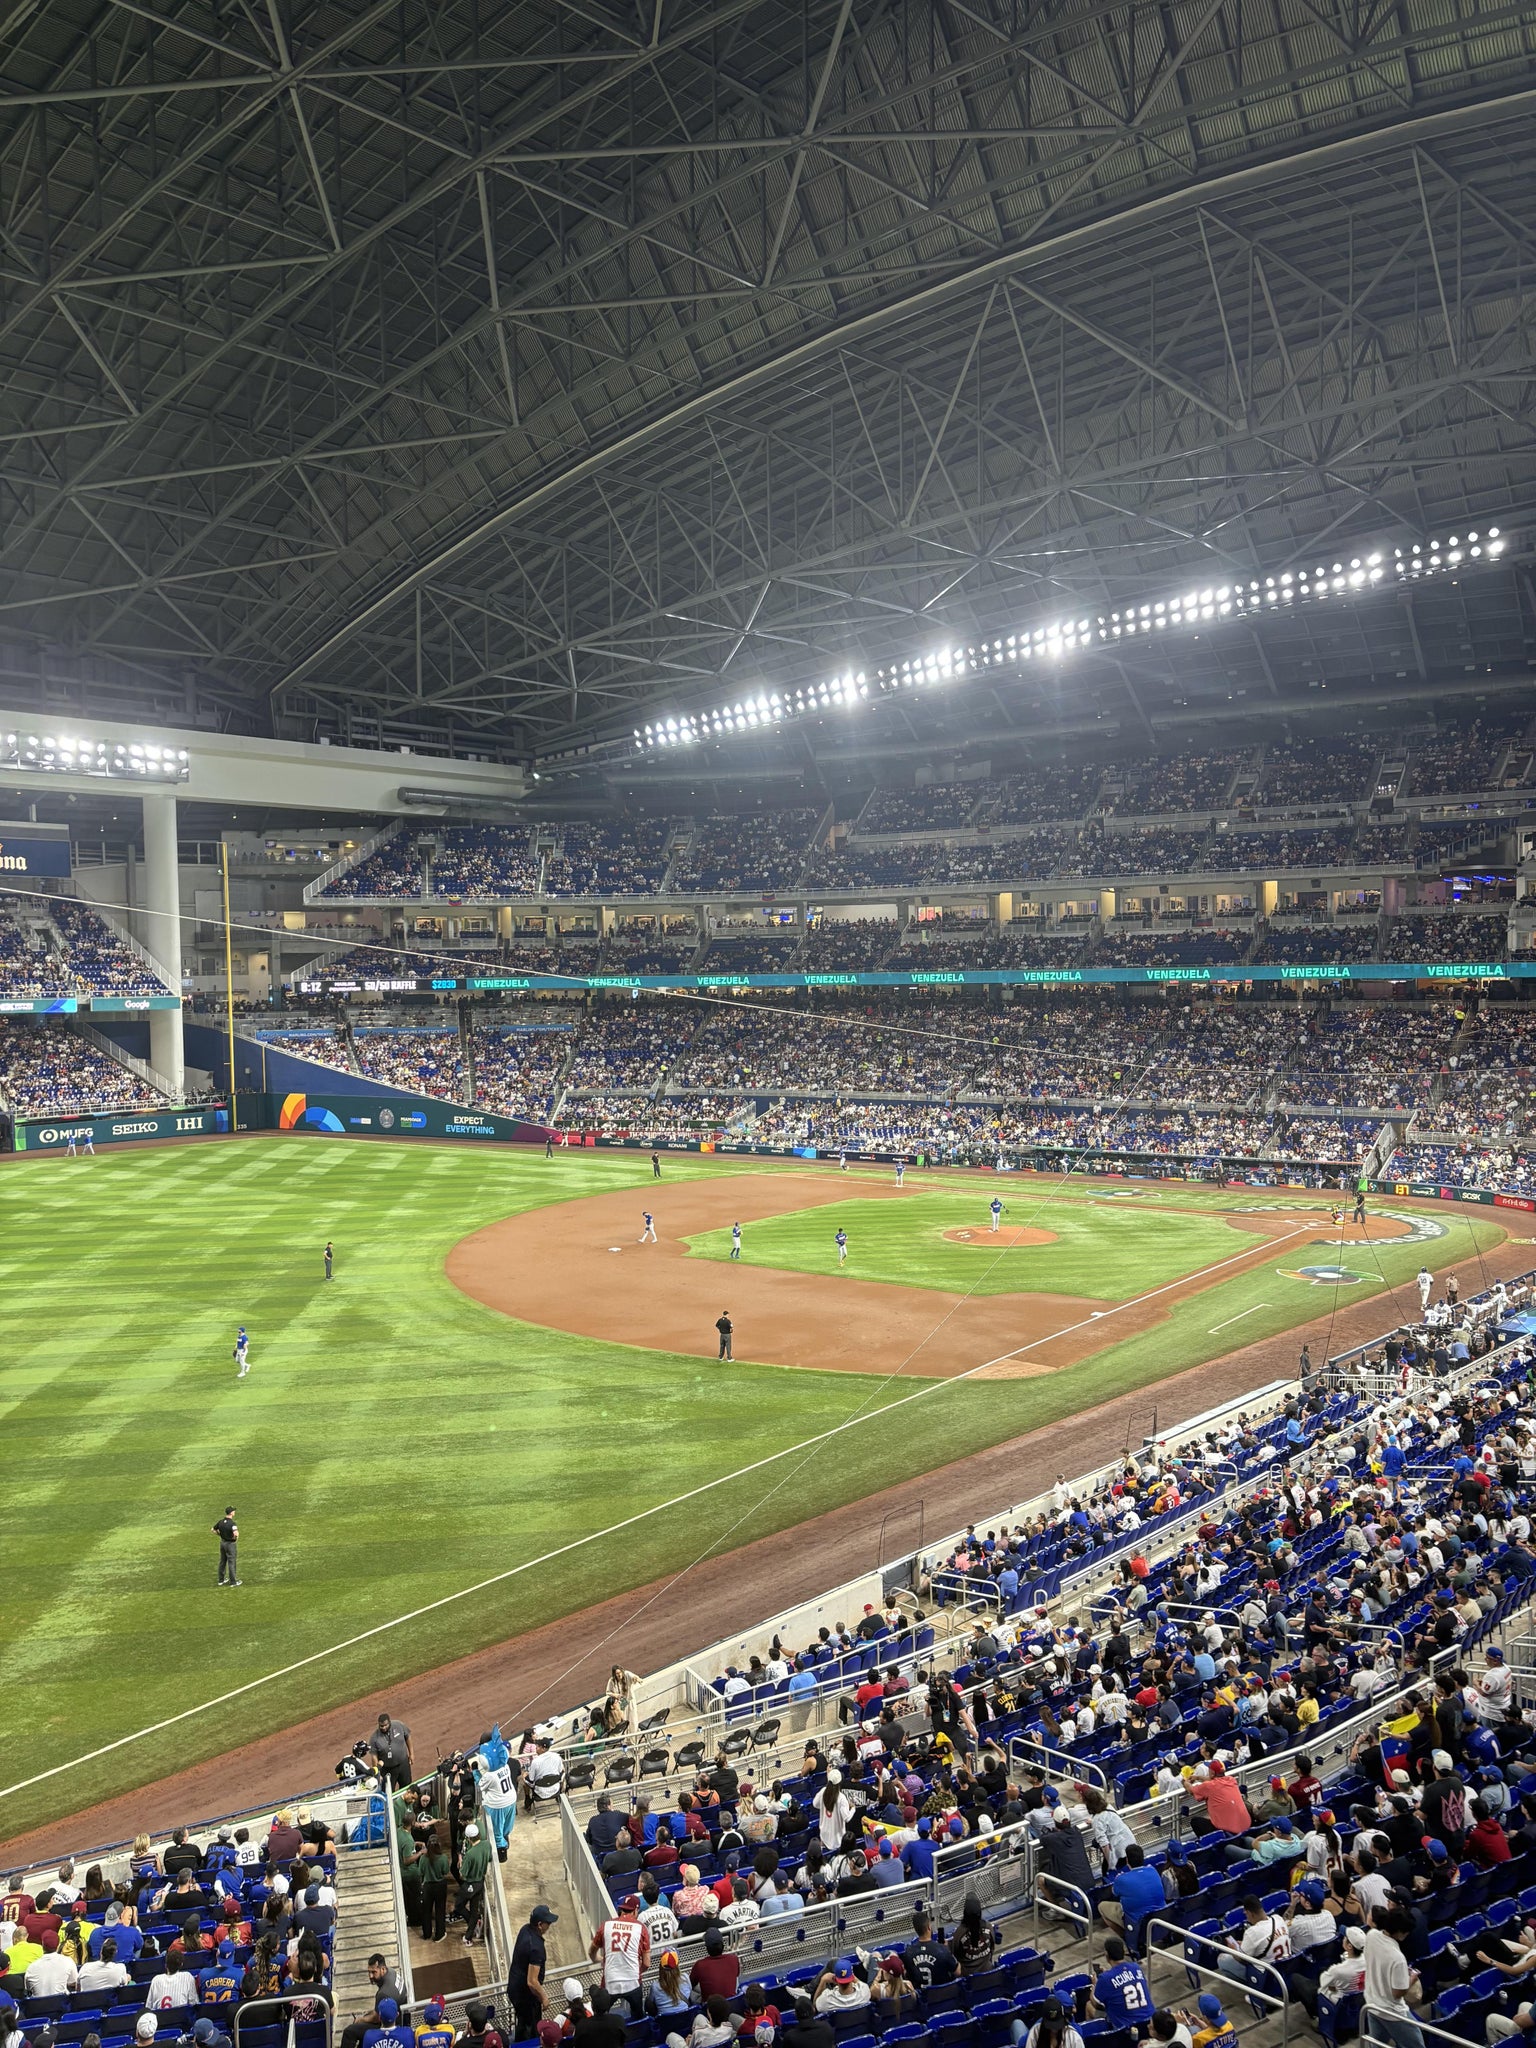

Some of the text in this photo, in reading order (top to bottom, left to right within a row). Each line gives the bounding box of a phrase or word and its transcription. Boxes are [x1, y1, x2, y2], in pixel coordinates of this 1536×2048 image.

[1023, 971, 1082, 981] VENEZUELA
[1147, 969, 1210, 980] VENEZUELA
[1281, 967, 1350, 978] VENEZUELA
[1427, 965, 1504, 977] VENEZUELA
[588, 978, 641, 987] VENEZUELA
[697, 976, 750, 985] VENEZUELA
[804, 975, 857, 985] VENEZUELA
[911, 973, 965, 983] VENEZUELA
[364, 980, 417, 992] 50/50 RAFFLE
[474, 980, 530, 988] VENEZUELA
[124, 999, 150, 1009] Google
[176, 1117, 203, 1131] IHI
[453, 1116, 485, 1125] EXPECT
[60, 1127, 94, 1140] MUFG
[112, 1121, 158, 1136] SEIKO
[445, 1124, 495, 1135] EVERYTHING
[1462, 1192, 1481, 1201] SCSK
[343, 1762, 357, 1778] 88
[241, 1850, 255, 1864] 99
[651, 1921, 671, 1942] 55
[611, 1931, 632, 1952] 27
[205, 1977, 236, 1988] CABRERA
[1111, 1970, 1136, 1989] ACUÑA
[1123, 1982, 1148, 2010] 21
